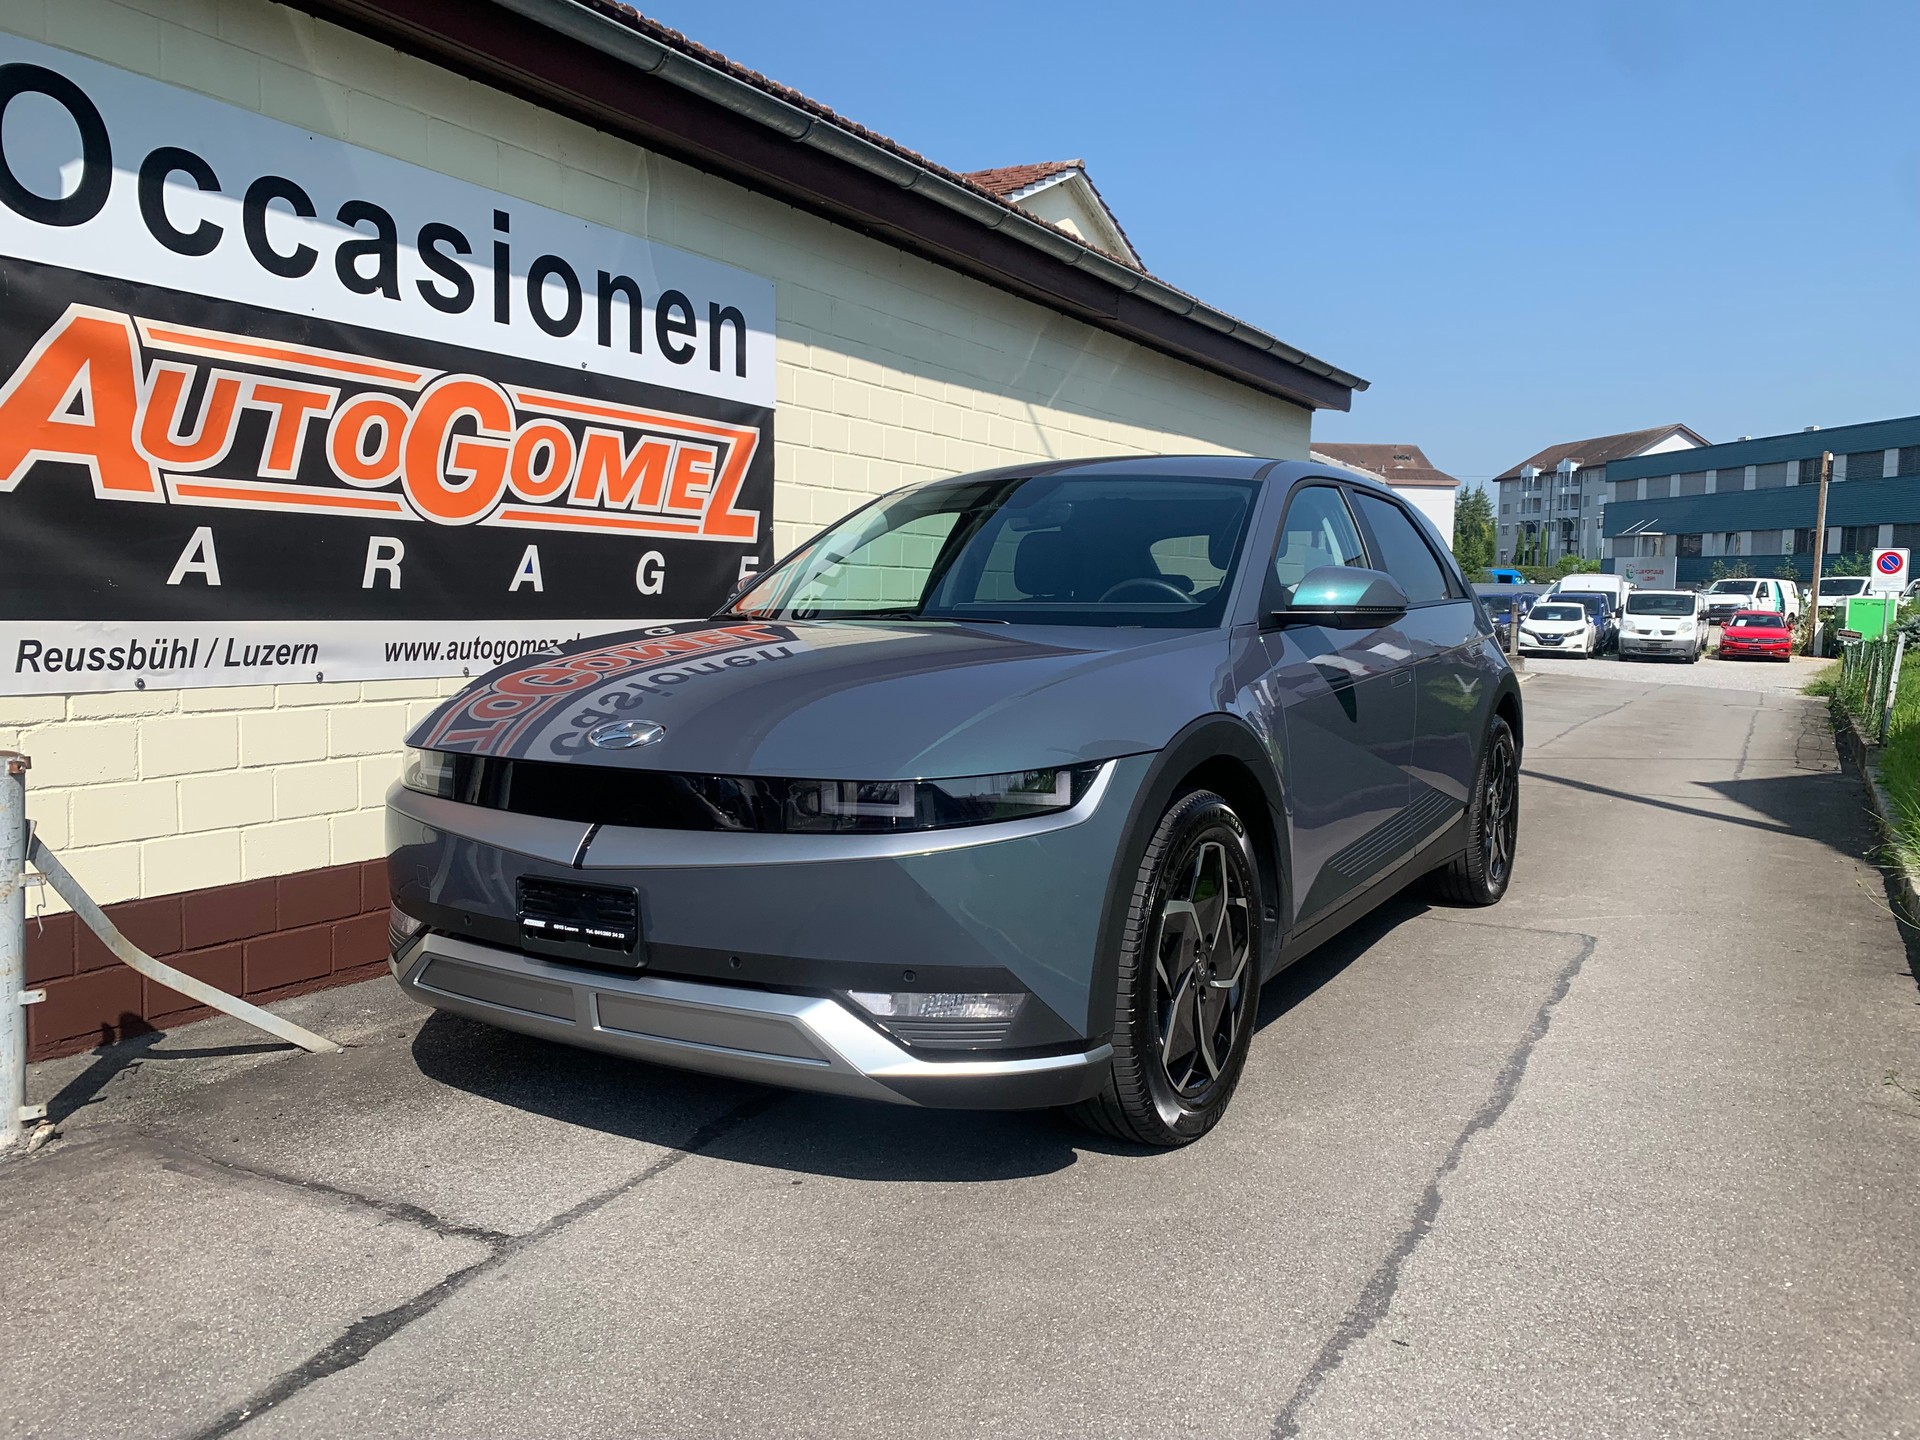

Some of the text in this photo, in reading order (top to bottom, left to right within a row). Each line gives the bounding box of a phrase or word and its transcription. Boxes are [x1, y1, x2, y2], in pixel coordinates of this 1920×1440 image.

[0, 62, 747, 378] Occasionen
[15, 637, 318, 673] Reussbühl / Luzern
